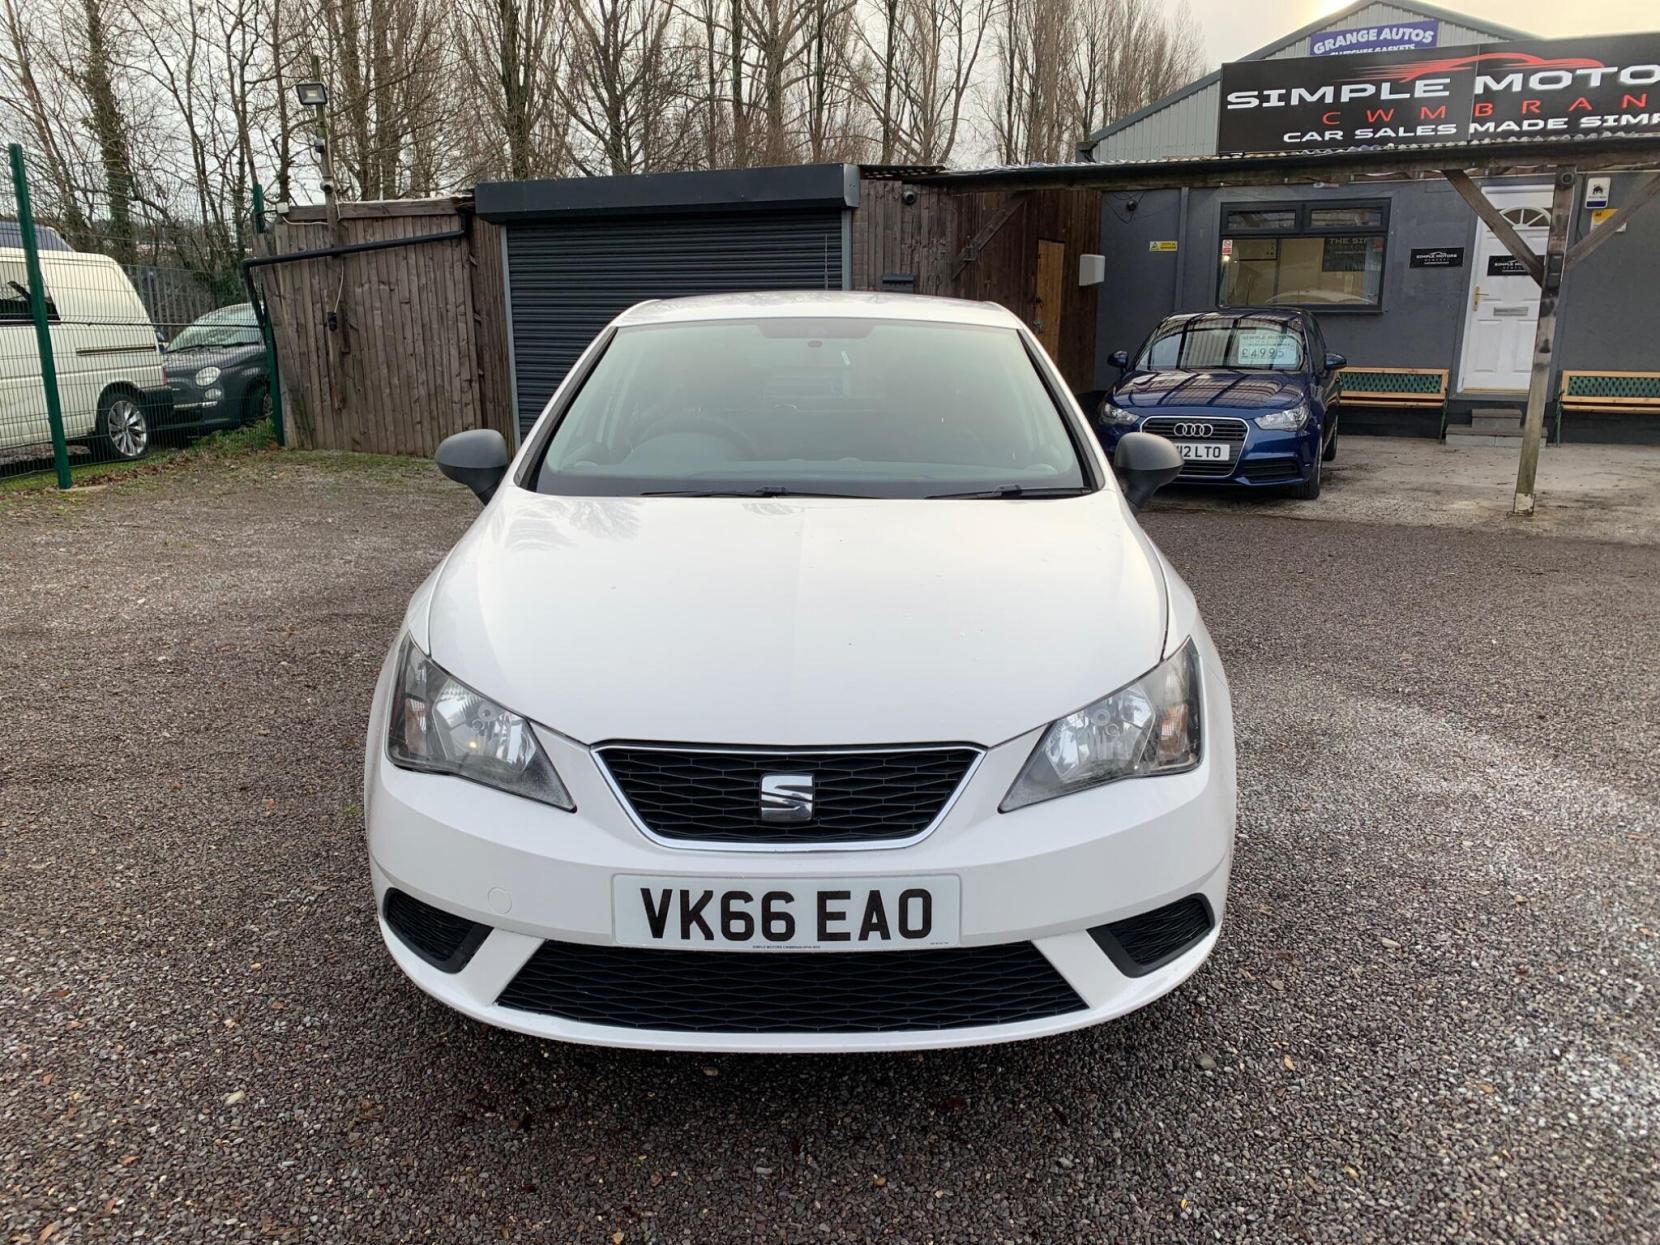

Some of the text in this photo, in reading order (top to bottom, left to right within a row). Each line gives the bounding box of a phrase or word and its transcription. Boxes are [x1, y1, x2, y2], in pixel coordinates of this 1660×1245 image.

[1313, 27, 1434, 54] GRANGE AUTOS
[1227, 64, 1660, 109] SIMPLE MOTO
[1322, 93, 1648, 125] CWMBRAN
[1283, 130, 1344, 143] CAR
[1354, 123, 1457, 139] SALES
[1469, 117, 1568, 134] MADE
[1176, 445, 1221, 458] 12 LTO
[640, 887, 932, 942] VK66 EAO
